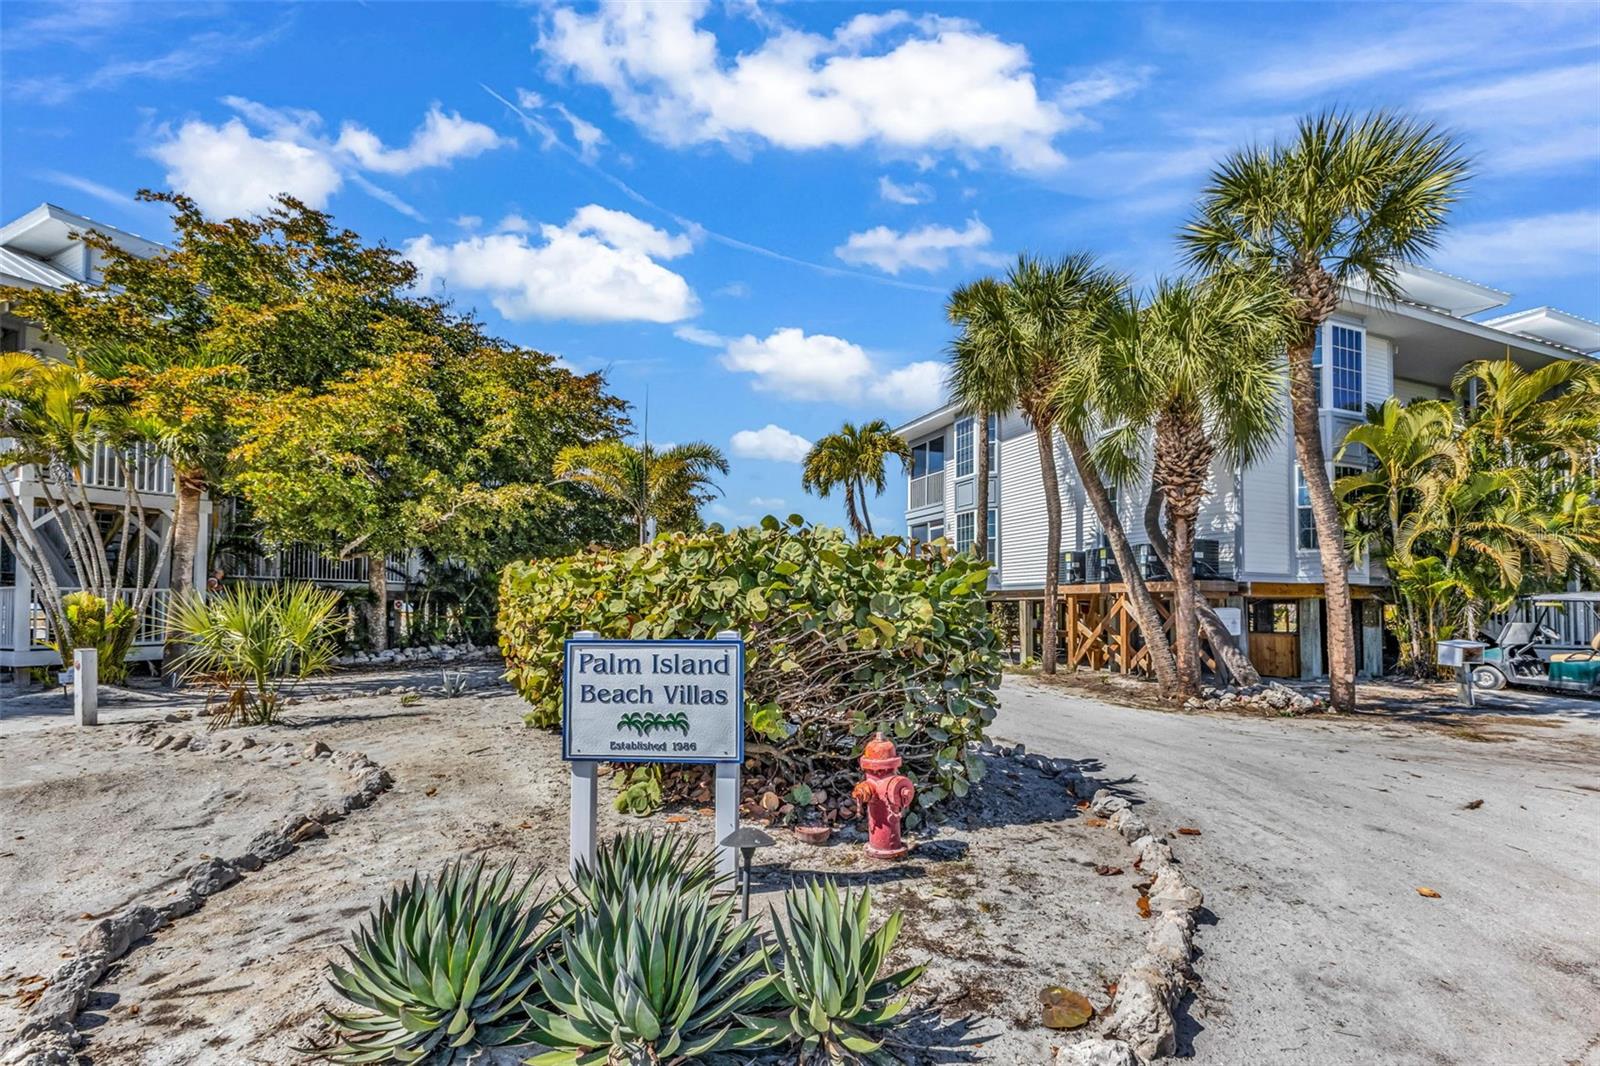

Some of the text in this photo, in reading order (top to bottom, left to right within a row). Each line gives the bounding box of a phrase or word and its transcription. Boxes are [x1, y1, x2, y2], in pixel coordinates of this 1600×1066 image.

[579, 653, 730, 676] Palm Island
[580, 684, 729, 705] Beach Villas
[610, 741, 697, 752] Established 1986
